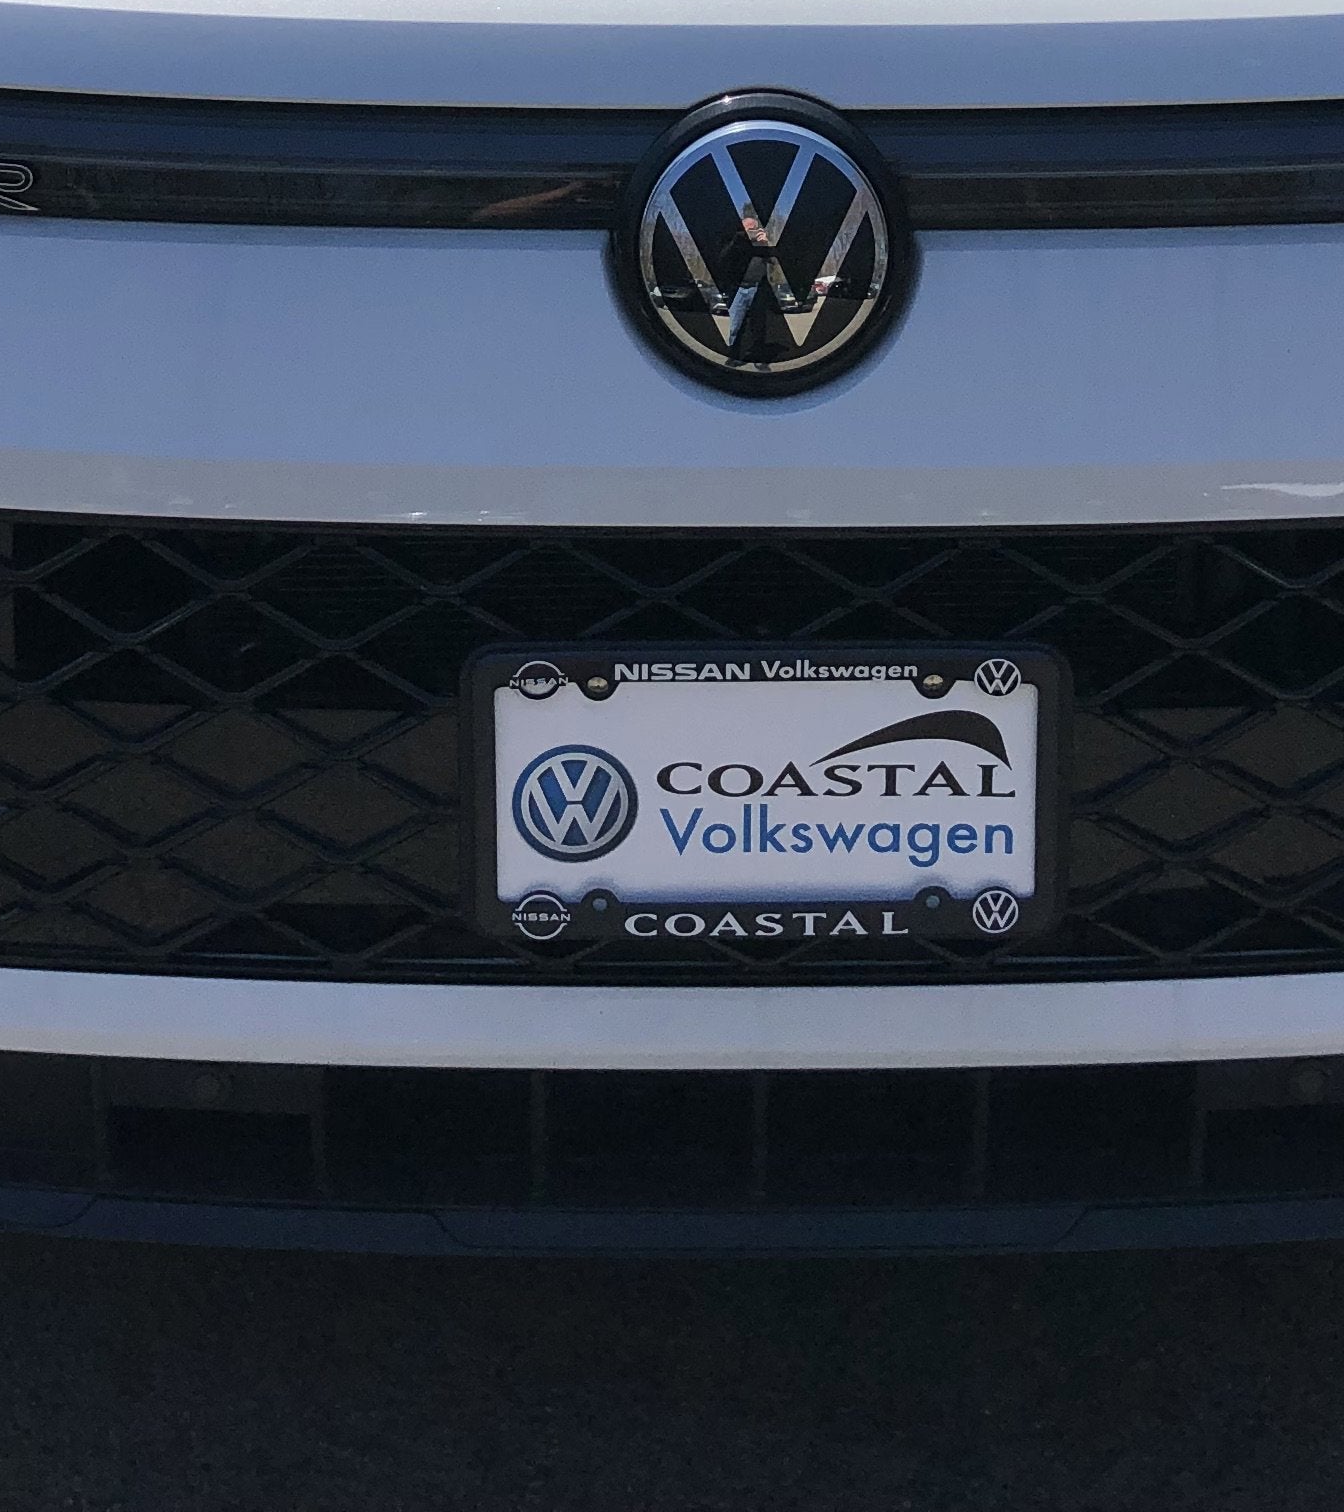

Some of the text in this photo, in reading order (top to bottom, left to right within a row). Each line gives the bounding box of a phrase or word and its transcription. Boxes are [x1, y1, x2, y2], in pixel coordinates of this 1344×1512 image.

[509, 675, 569, 687] NISSAN
[613, 660, 919, 681] NISSAN Volkswagen
[656, 761, 1016, 798] COASTAL
[659, 803, 1014, 868] Volkswagen
[512, 912, 571, 922] NISSAN
[624, 911, 909, 937] COASTAL
